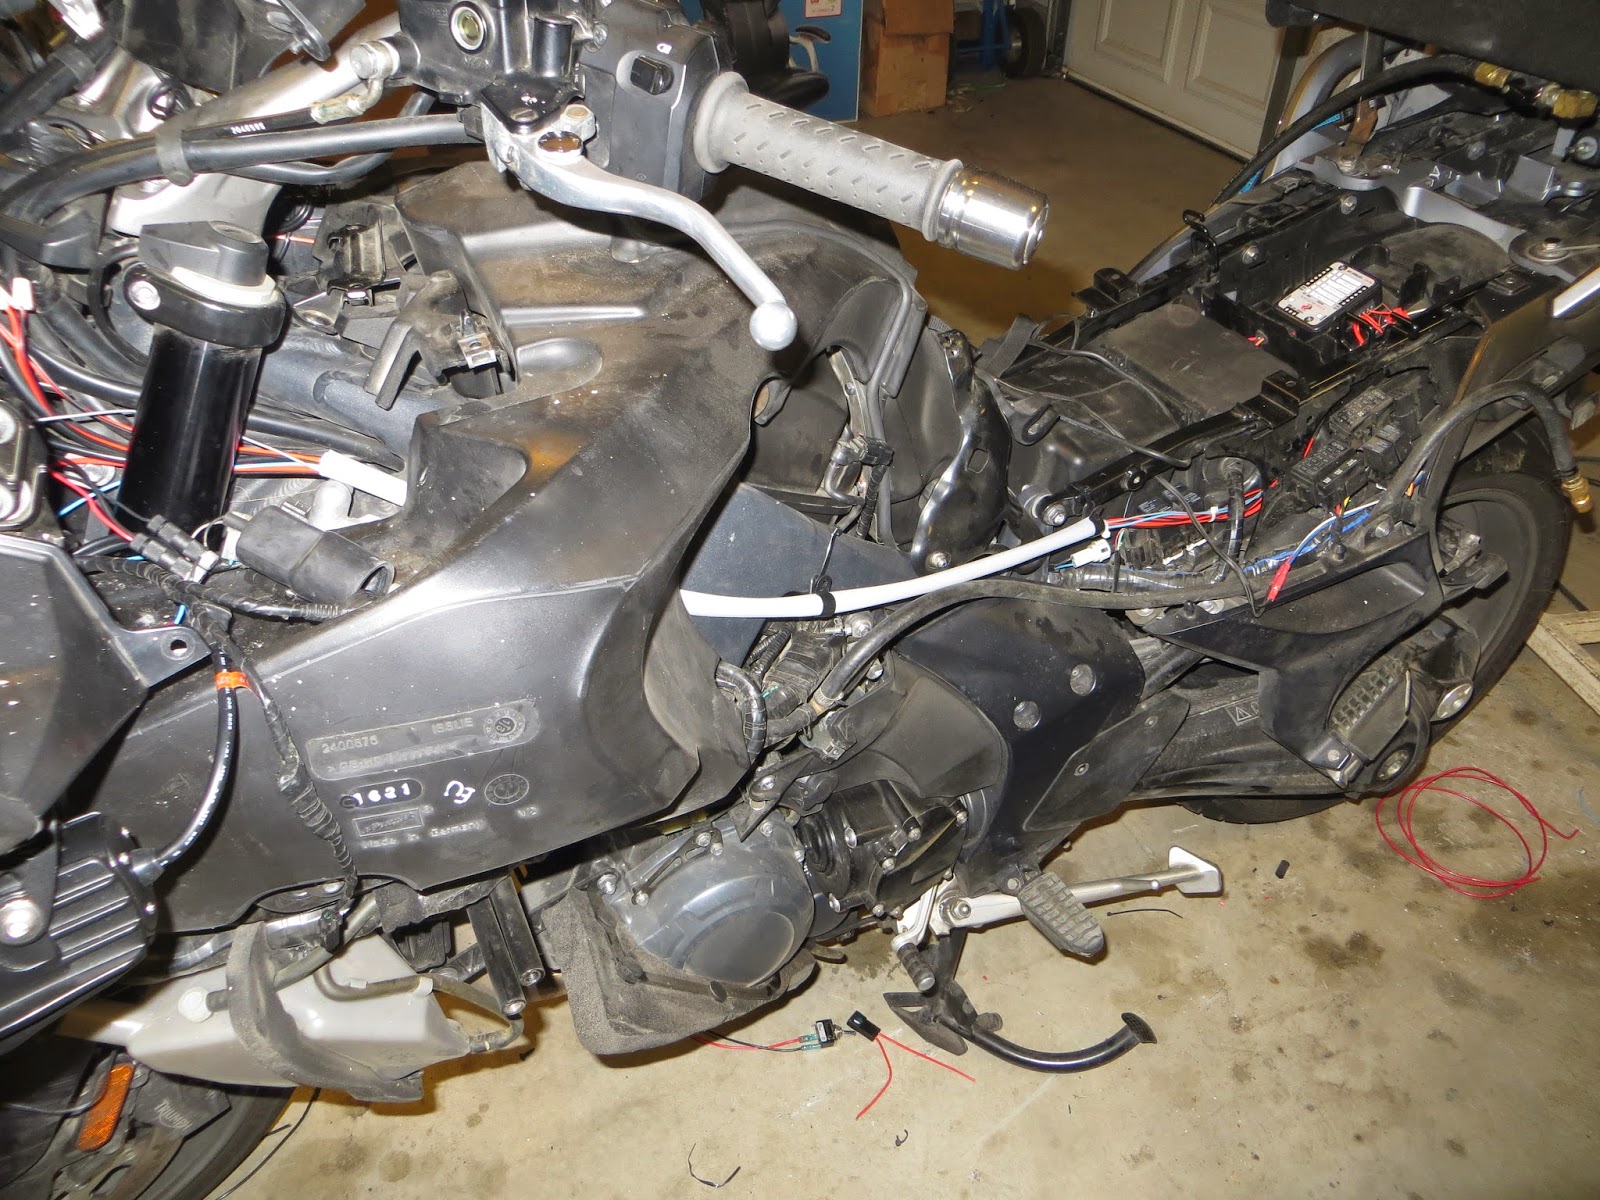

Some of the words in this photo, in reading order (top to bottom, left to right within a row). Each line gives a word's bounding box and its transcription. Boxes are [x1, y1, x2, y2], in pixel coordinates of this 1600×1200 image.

[431, 717, 474, 735] ISSUE
[360, 836, 398, 849] Made
[429, 821, 484, 838] Germany
[153, 1099, 193, 1131] TRIUMPH
